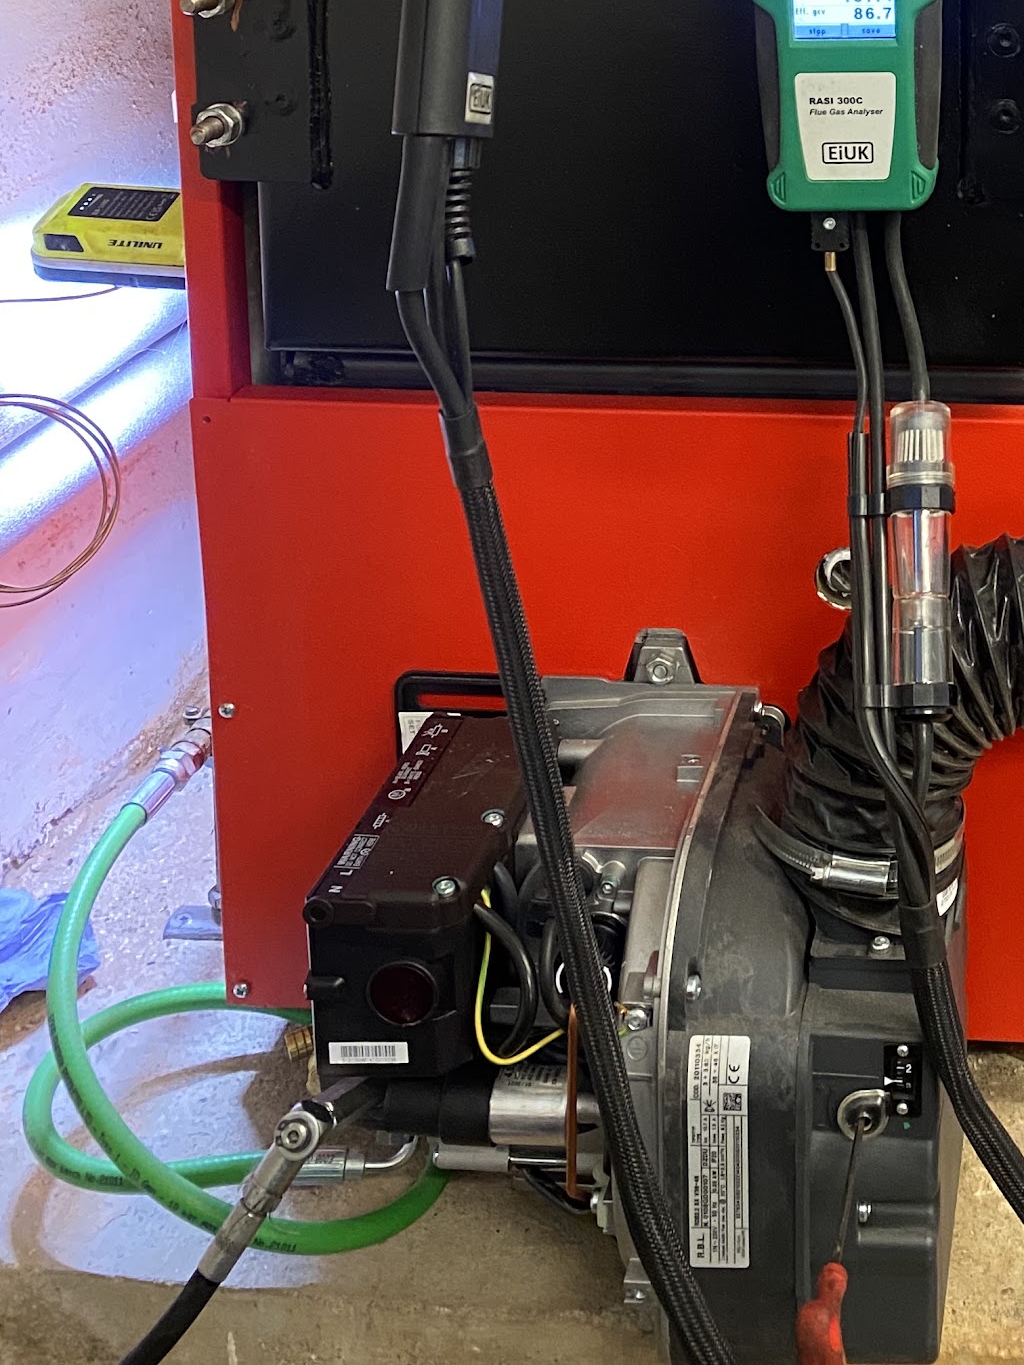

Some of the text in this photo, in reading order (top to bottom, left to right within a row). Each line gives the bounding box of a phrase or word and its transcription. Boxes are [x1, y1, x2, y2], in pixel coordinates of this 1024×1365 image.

[854, 7, 892, 20] 86.7
[809, 28, 827, 36] stop
[809, 97, 863, 105] RASI 300C
[809, 108, 884, 117] Flue Gas Analyser
[828, 145, 869, 160] EiUK
[108, 239, 163, 249] UNILITE
[337, 836, 361, 865] WARNING
[328, 885, 343, 894] N
[905, 1064, 912, 1074] 2
